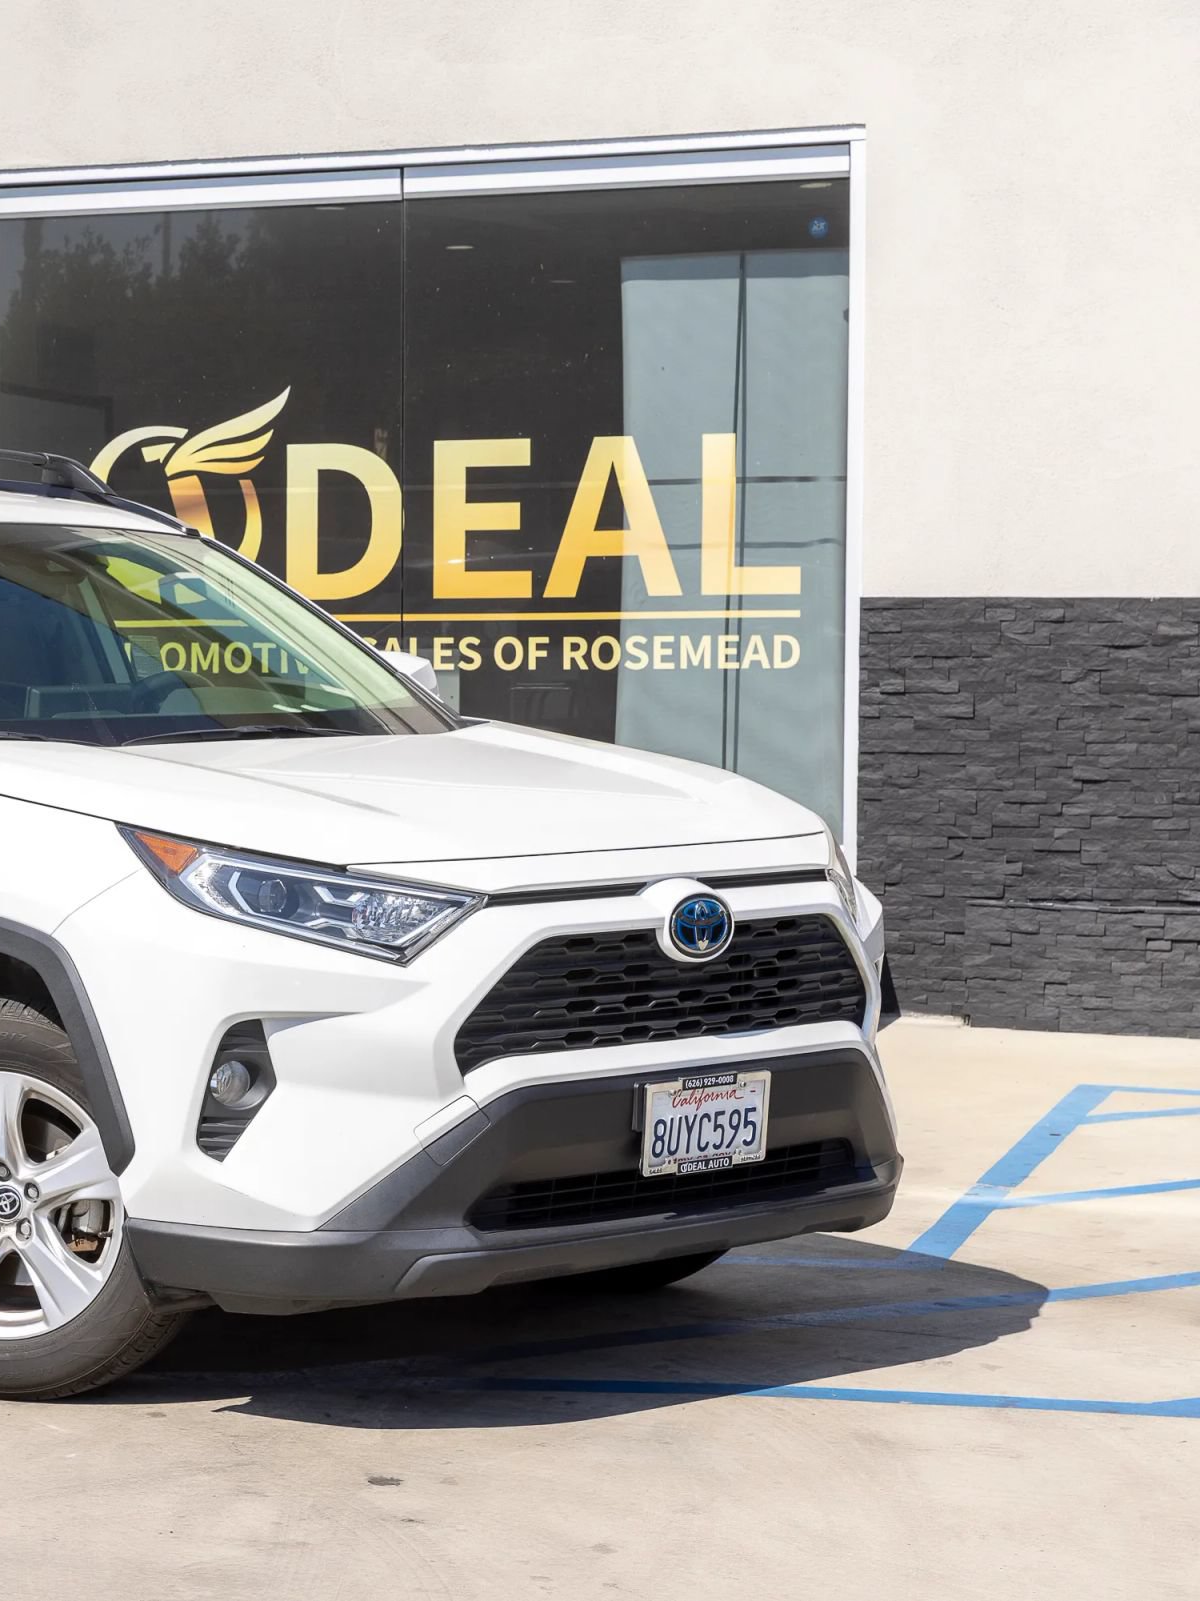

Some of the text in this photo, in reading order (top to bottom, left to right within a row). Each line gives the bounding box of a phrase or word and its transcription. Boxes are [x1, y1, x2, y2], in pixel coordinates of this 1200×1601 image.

[493, 635, 550, 671] OF
[562, 633, 801, 671] ROSEMEAD
[685, 1078, 703, 1089] (626)
[672, 1087, 744, 1112] California
[651, 1106, 757, 1159] 8UYC595
[707, 1157, 730, 1169] AUTO
